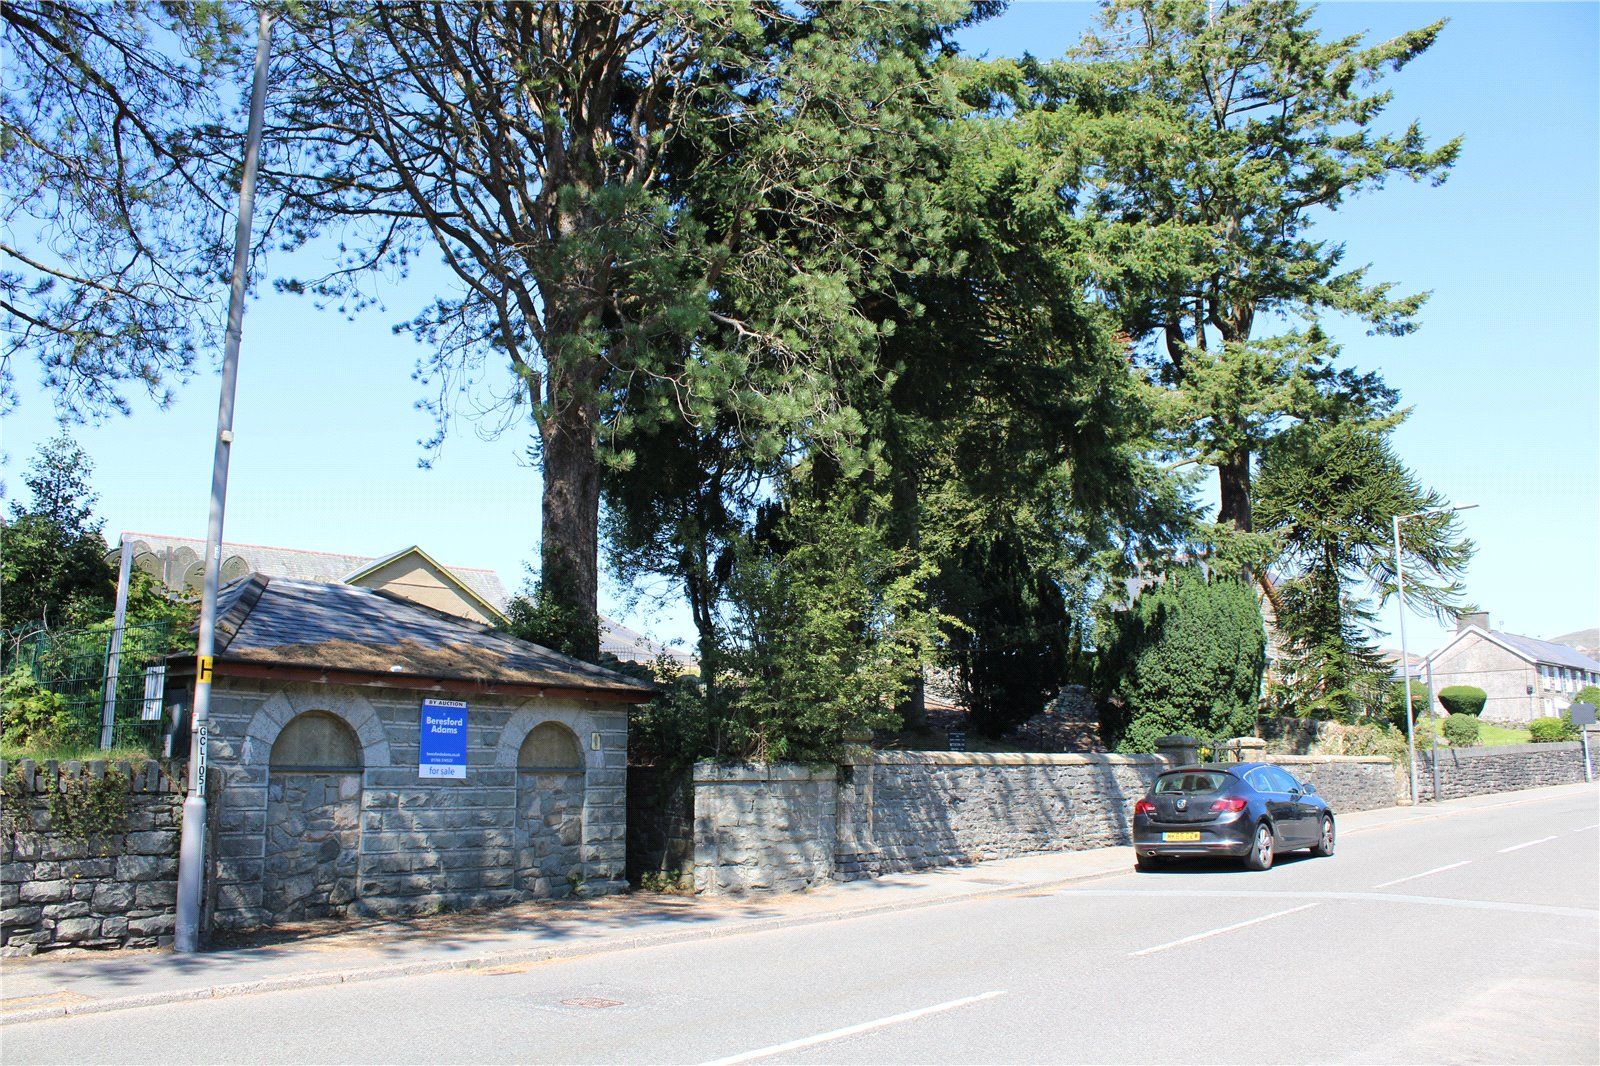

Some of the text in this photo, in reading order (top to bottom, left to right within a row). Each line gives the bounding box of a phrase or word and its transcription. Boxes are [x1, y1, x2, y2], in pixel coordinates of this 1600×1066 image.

[426, 716, 463, 726] Beresford
[431, 725, 458, 734] Adams
[429, 766, 456, 776] for sale
